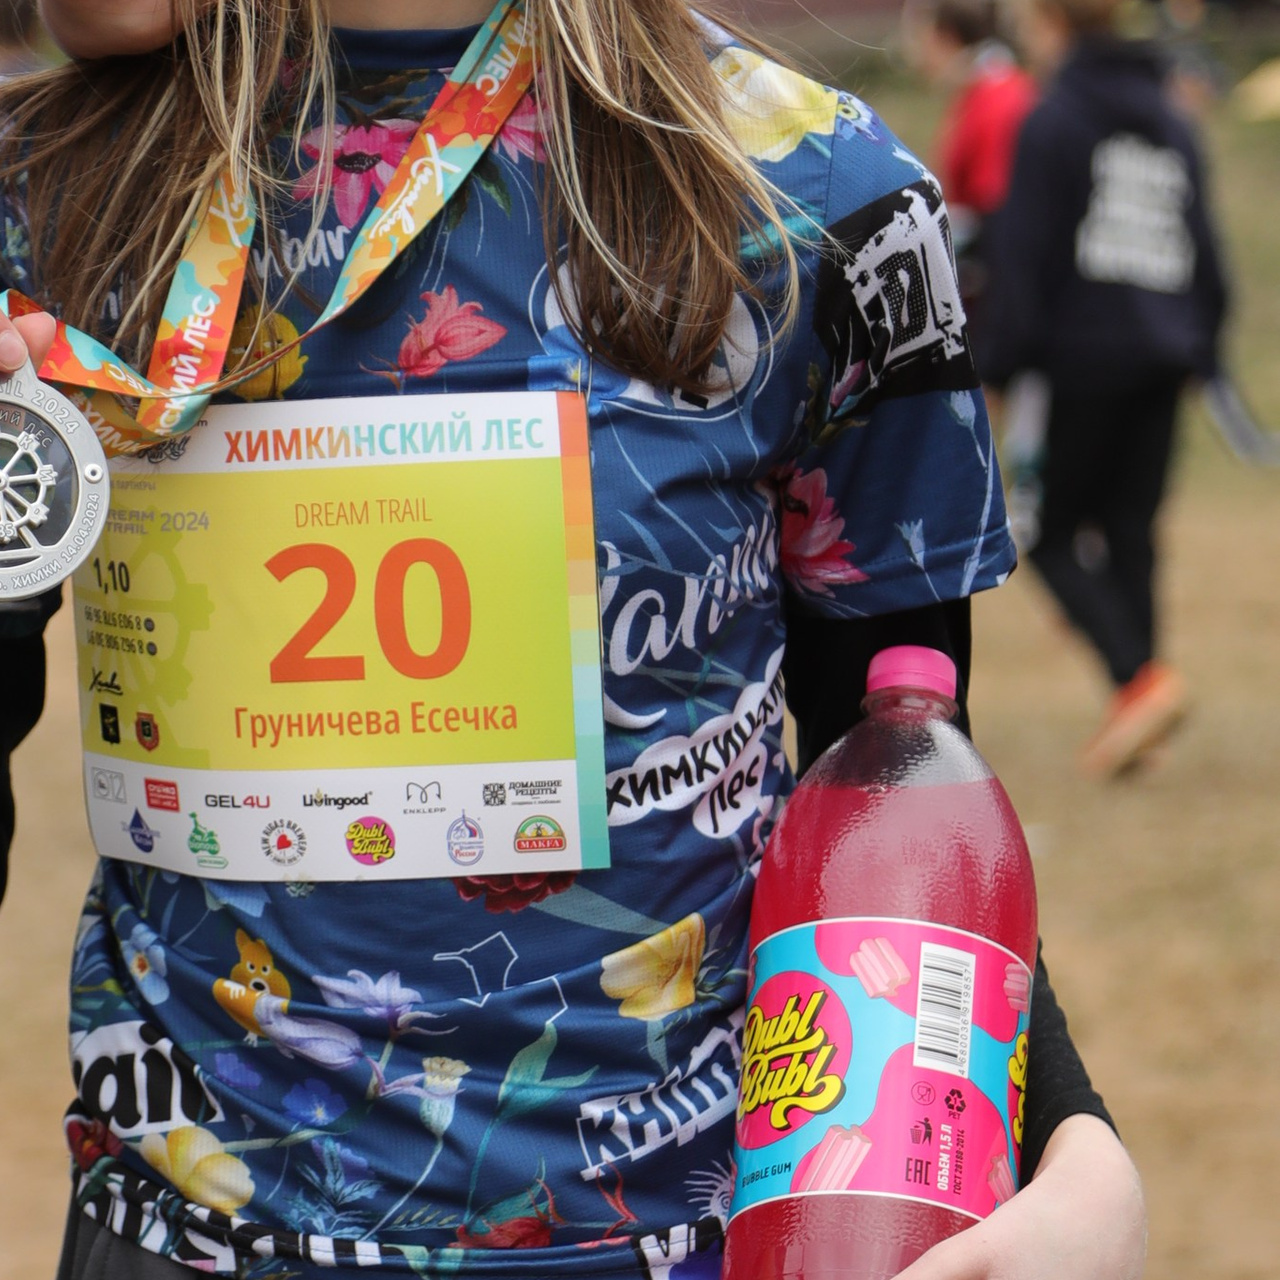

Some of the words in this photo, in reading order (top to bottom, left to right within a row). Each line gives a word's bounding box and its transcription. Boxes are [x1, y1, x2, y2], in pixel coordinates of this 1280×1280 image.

[183, 294, 216, 351] ЛЕС
[31, 389, 80, 435] 2024
[24, 422, 53, 448] ЛЕС
[224, 412, 473, 464] ХИМКИНСКИЙ
[483, 417, 544, 451] ЛЕС
[108, 508, 155, 522] REAM
[160, 511, 211, 532] 2024
[294, 500, 371, 528] DREAM
[376, 497, 433, 525] TRAIL
[12, 560, 62, 589] ХИМКИ
[61, 493, 101, 563] 14.04.2024
[93, 556, 131, 595] 1,10
[263, 538, 472, 684] 20
[234, 706, 401, 748] Груничева
[411, 701, 519, 734] Есечка
[508, 779, 563, 791] ДОМАШНИЕ
[515, 787, 558, 797] РЕЦЕПТЫ
[204, 793, 271, 809] GEL4U
[261, 837, 272, 858] NEW
[286, 819, 308, 858] BREWERY
[346, 823, 387, 841] Dubl
[520, 839, 561, 849] MAKFA
[742, 990, 825, 1058] Dubl
[959, 1017, 969, 1064] 680036
[737, 1042, 846, 1130] Bubl
[941, 1123, 953, 1132] Л
[948, 1110, 961, 1120] PET
[940, 1132, 953, 1152] 1,5
[954, 1128, 966, 1167] 28188-2014
[741, 1166, 770, 1188] BUBBLE
[771, 1161, 792, 1176] GUM
[937, 1155, 950, 1191] ОБЪЕМ
[953, 1168, 963, 1196] ГОСТ
